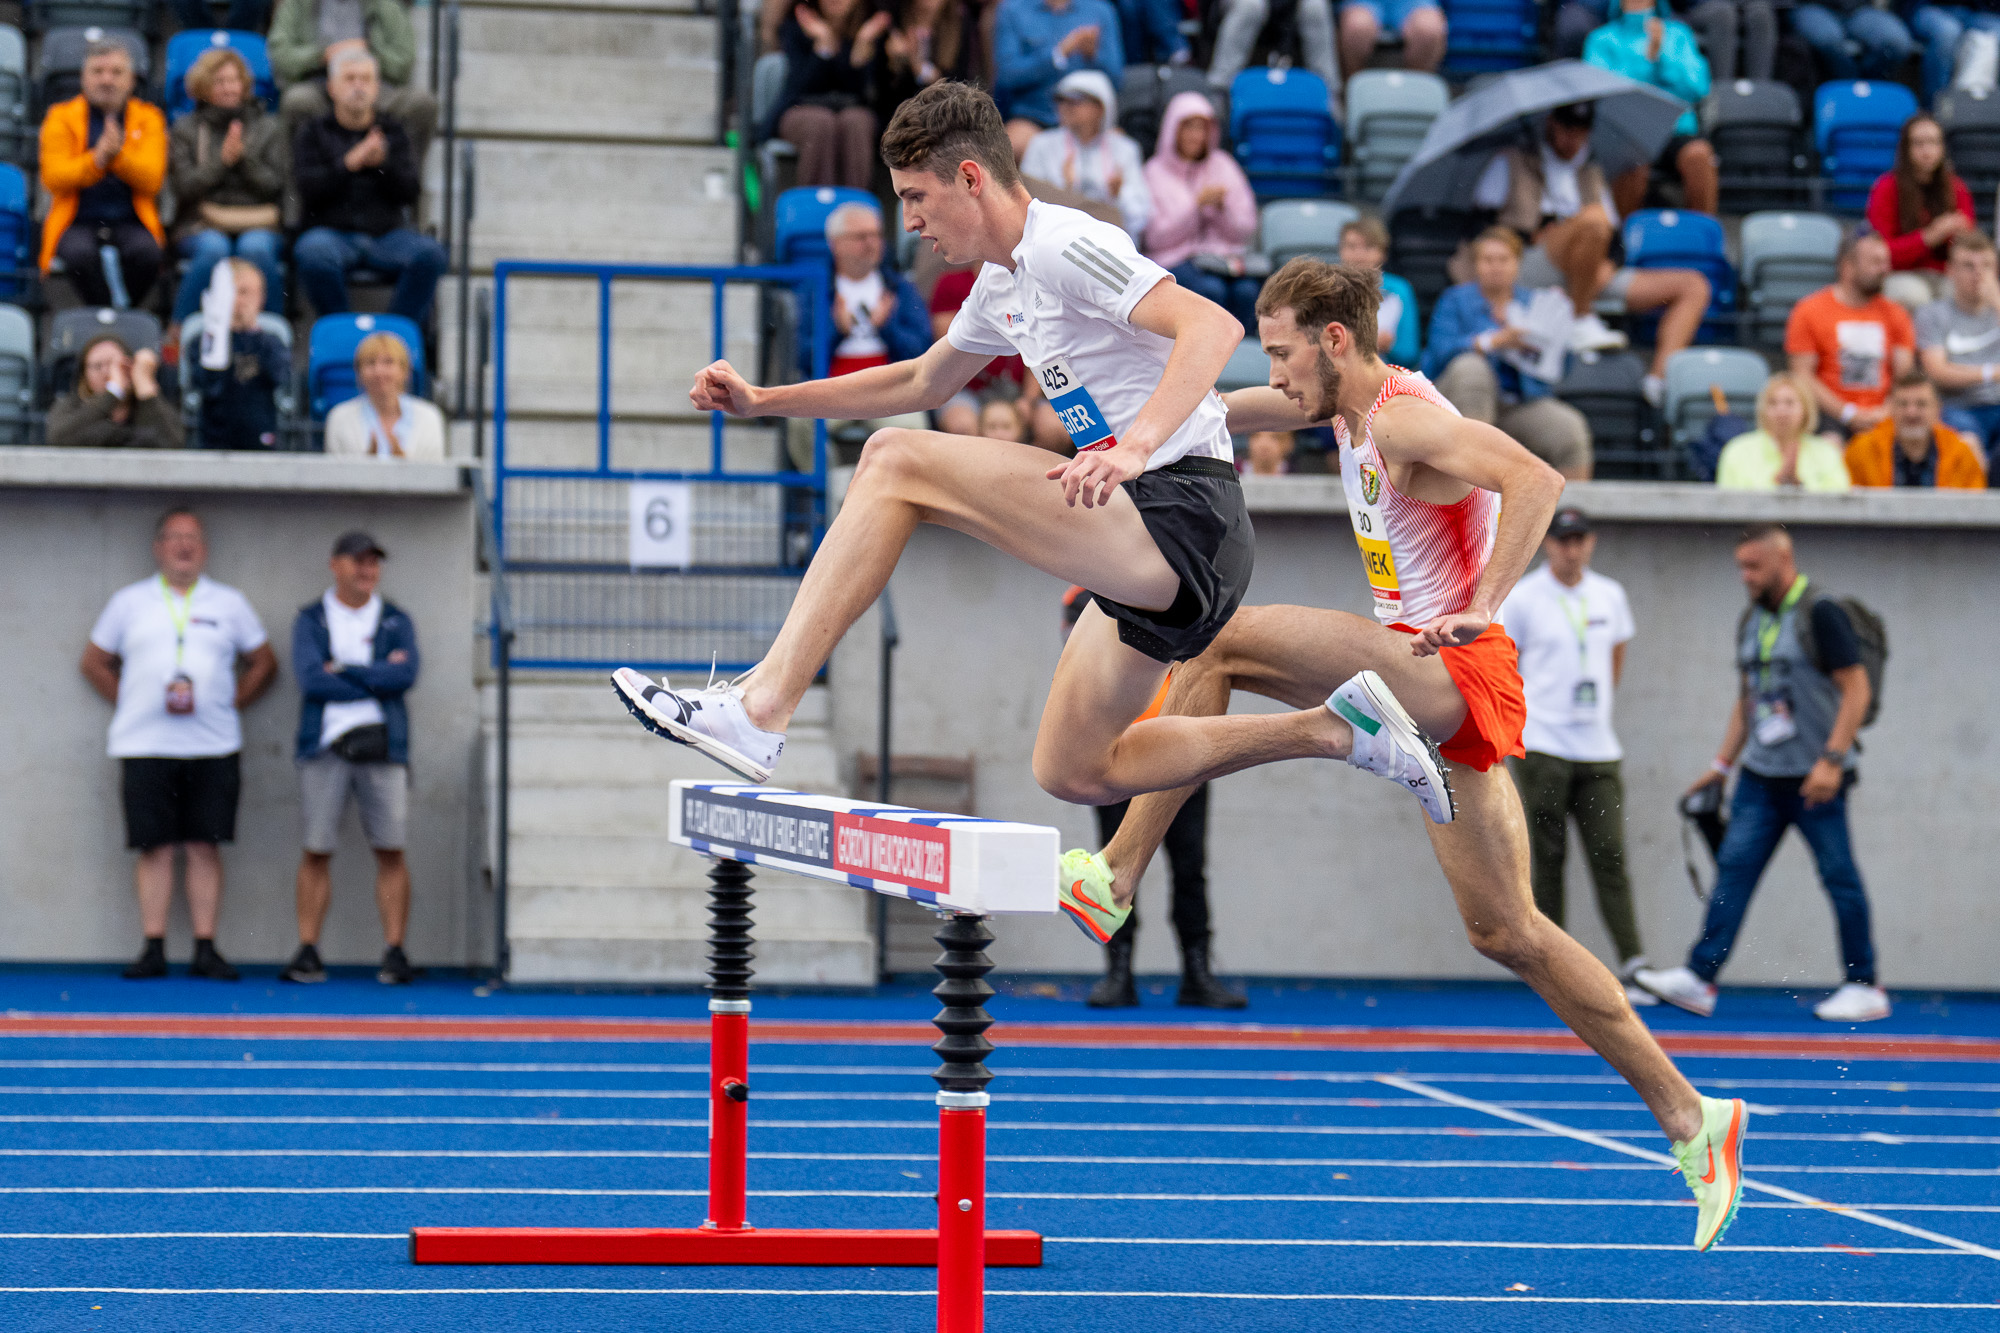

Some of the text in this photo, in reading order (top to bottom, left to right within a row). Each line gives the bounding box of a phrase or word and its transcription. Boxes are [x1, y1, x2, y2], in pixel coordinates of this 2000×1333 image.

[1042, 364, 1069, 391] 425
[1055, 404, 1097, 435] GIER
[644, 495, 673, 543] 6
[1357, 510, 1372, 533] 30
[1360, 546, 1391, 577] NEK
[837, 817, 871, 869] GORZÓW
[924, 840, 945, 885] 2023
